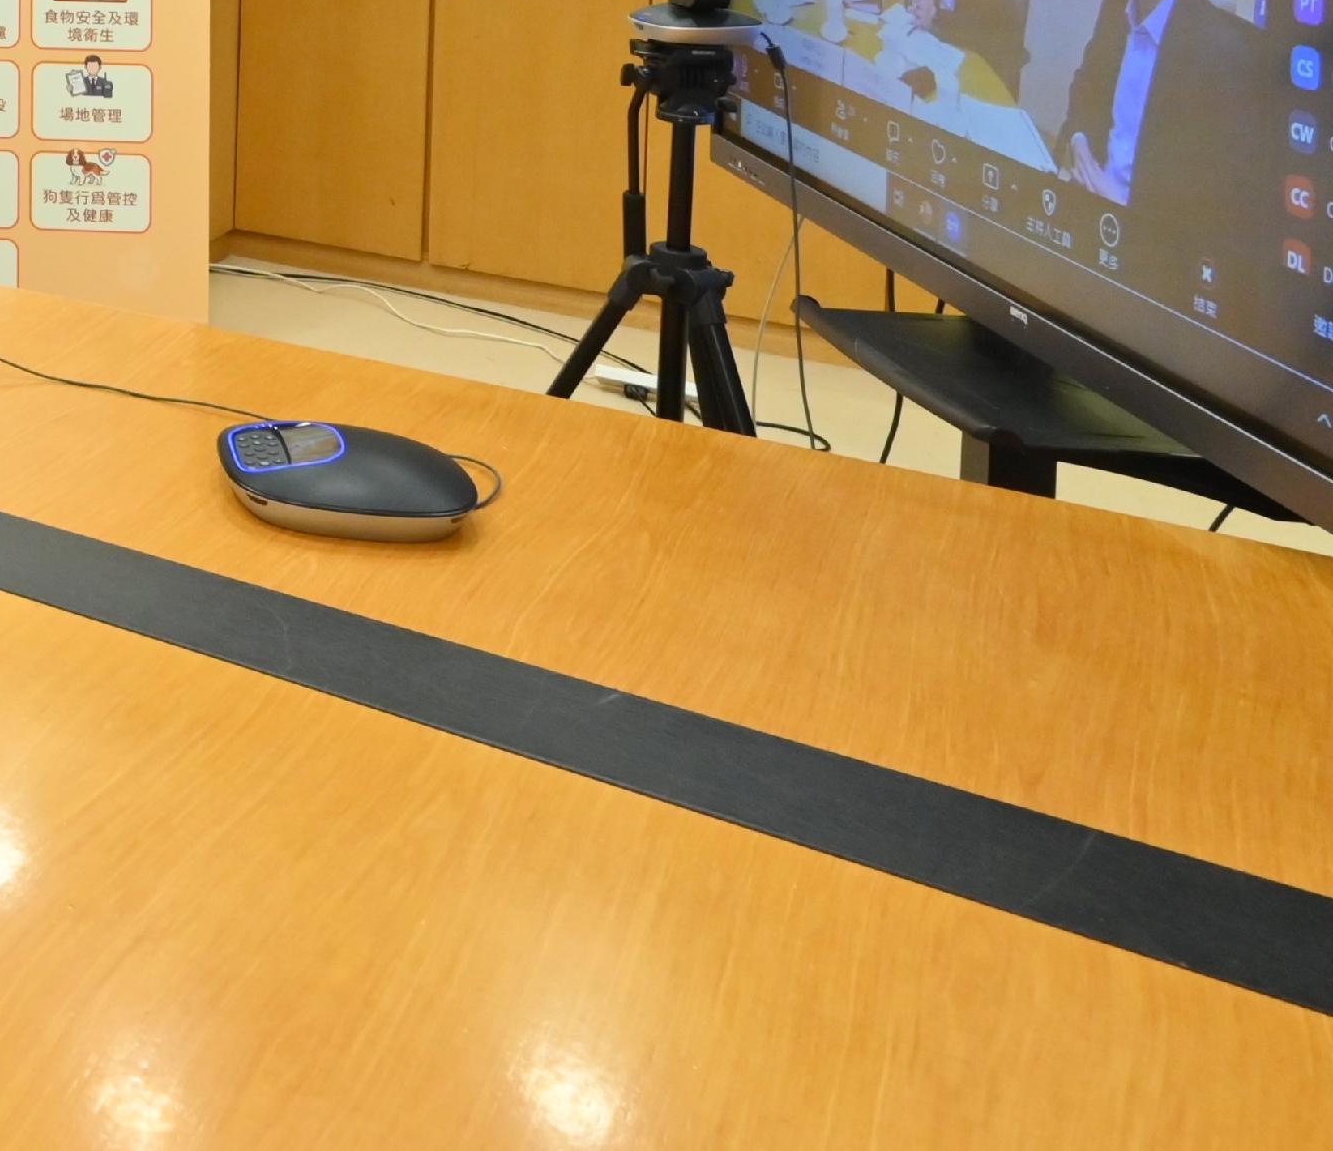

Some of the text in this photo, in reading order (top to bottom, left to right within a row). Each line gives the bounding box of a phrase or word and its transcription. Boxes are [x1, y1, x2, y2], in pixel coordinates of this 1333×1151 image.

[44, 9, 140, 27] 食物安全及環
[1297, 58, 1314, 79] CS
[59, 107, 122, 124] 場地管理
[1291, 122, 1314, 145] CW
[66, 207, 114, 223] 及健康
[1287, 250, 1306, 274] DL
